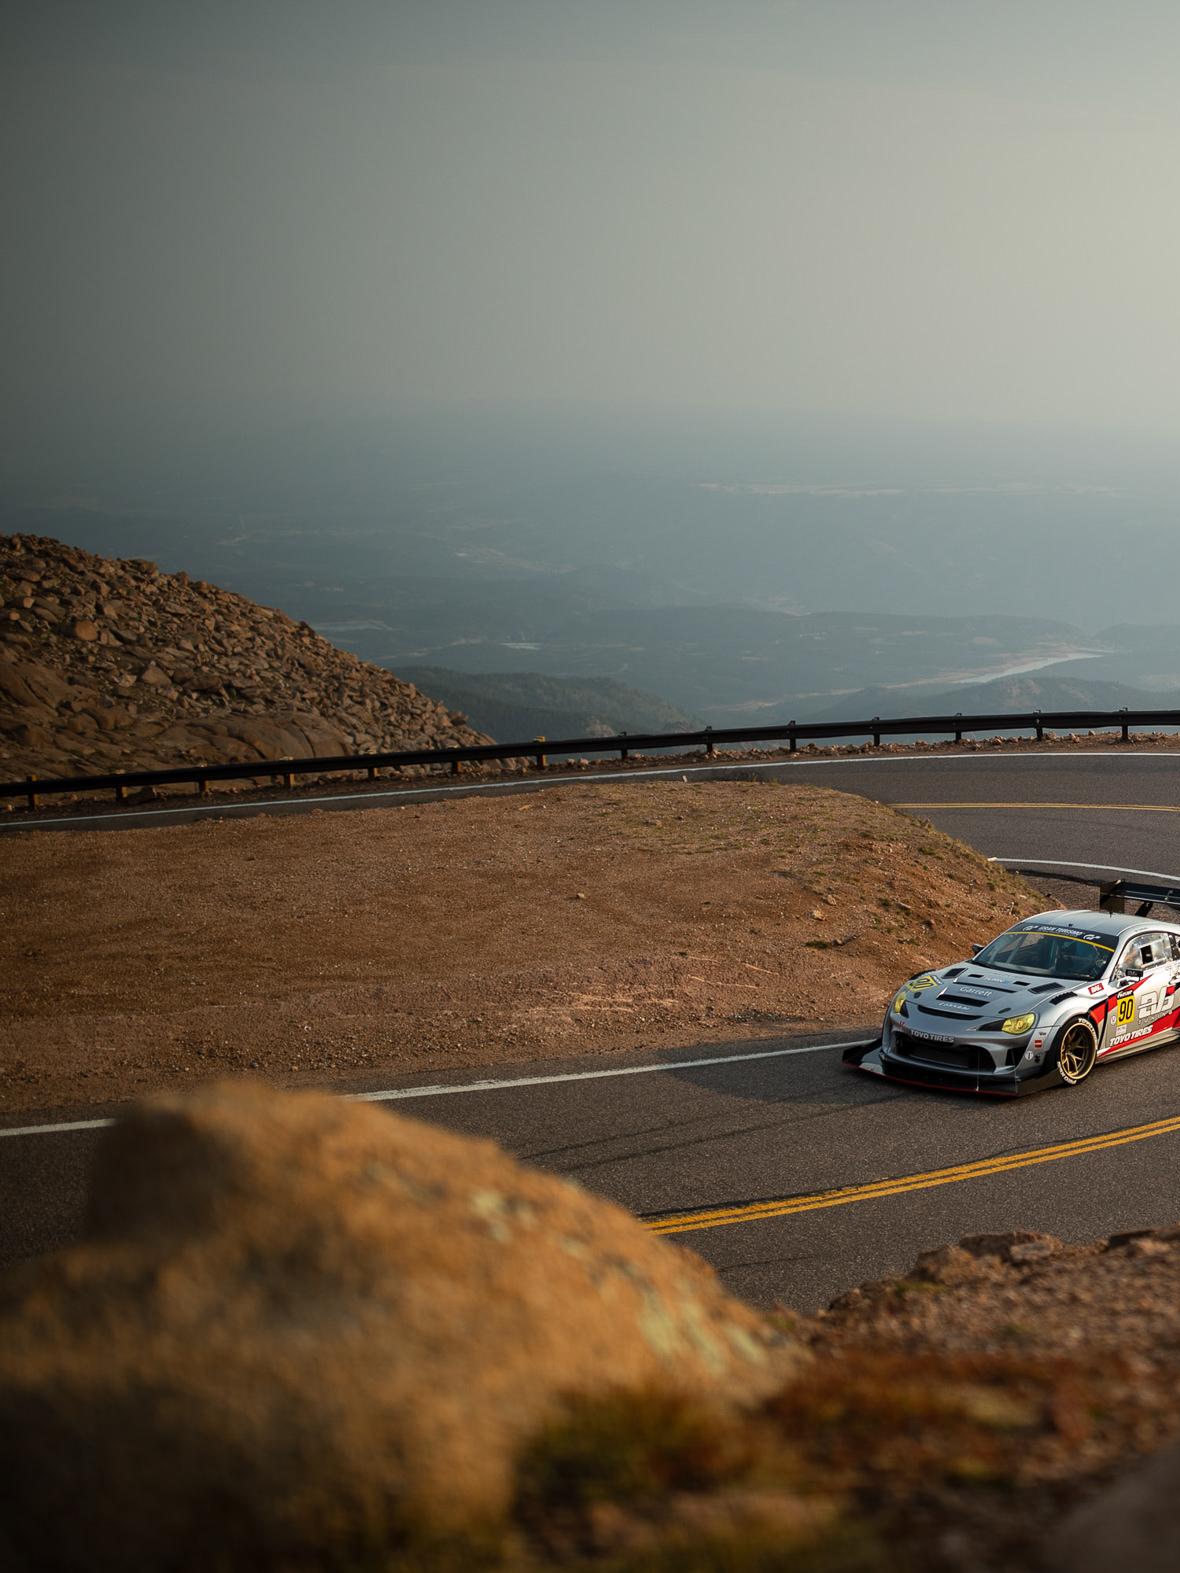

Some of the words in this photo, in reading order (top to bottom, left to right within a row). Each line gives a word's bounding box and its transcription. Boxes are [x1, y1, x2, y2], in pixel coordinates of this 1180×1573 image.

[960, 986, 993, 997] Garrett
[1118, 999, 1133, 1022] 90
[910, 1028, 929, 1039] TOYO
[930, 1034, 955, 1043] TIRES
[1110, 1032, 1131, 1046] TOYO
[1130, 1025, 1153, 1039] TIRES
